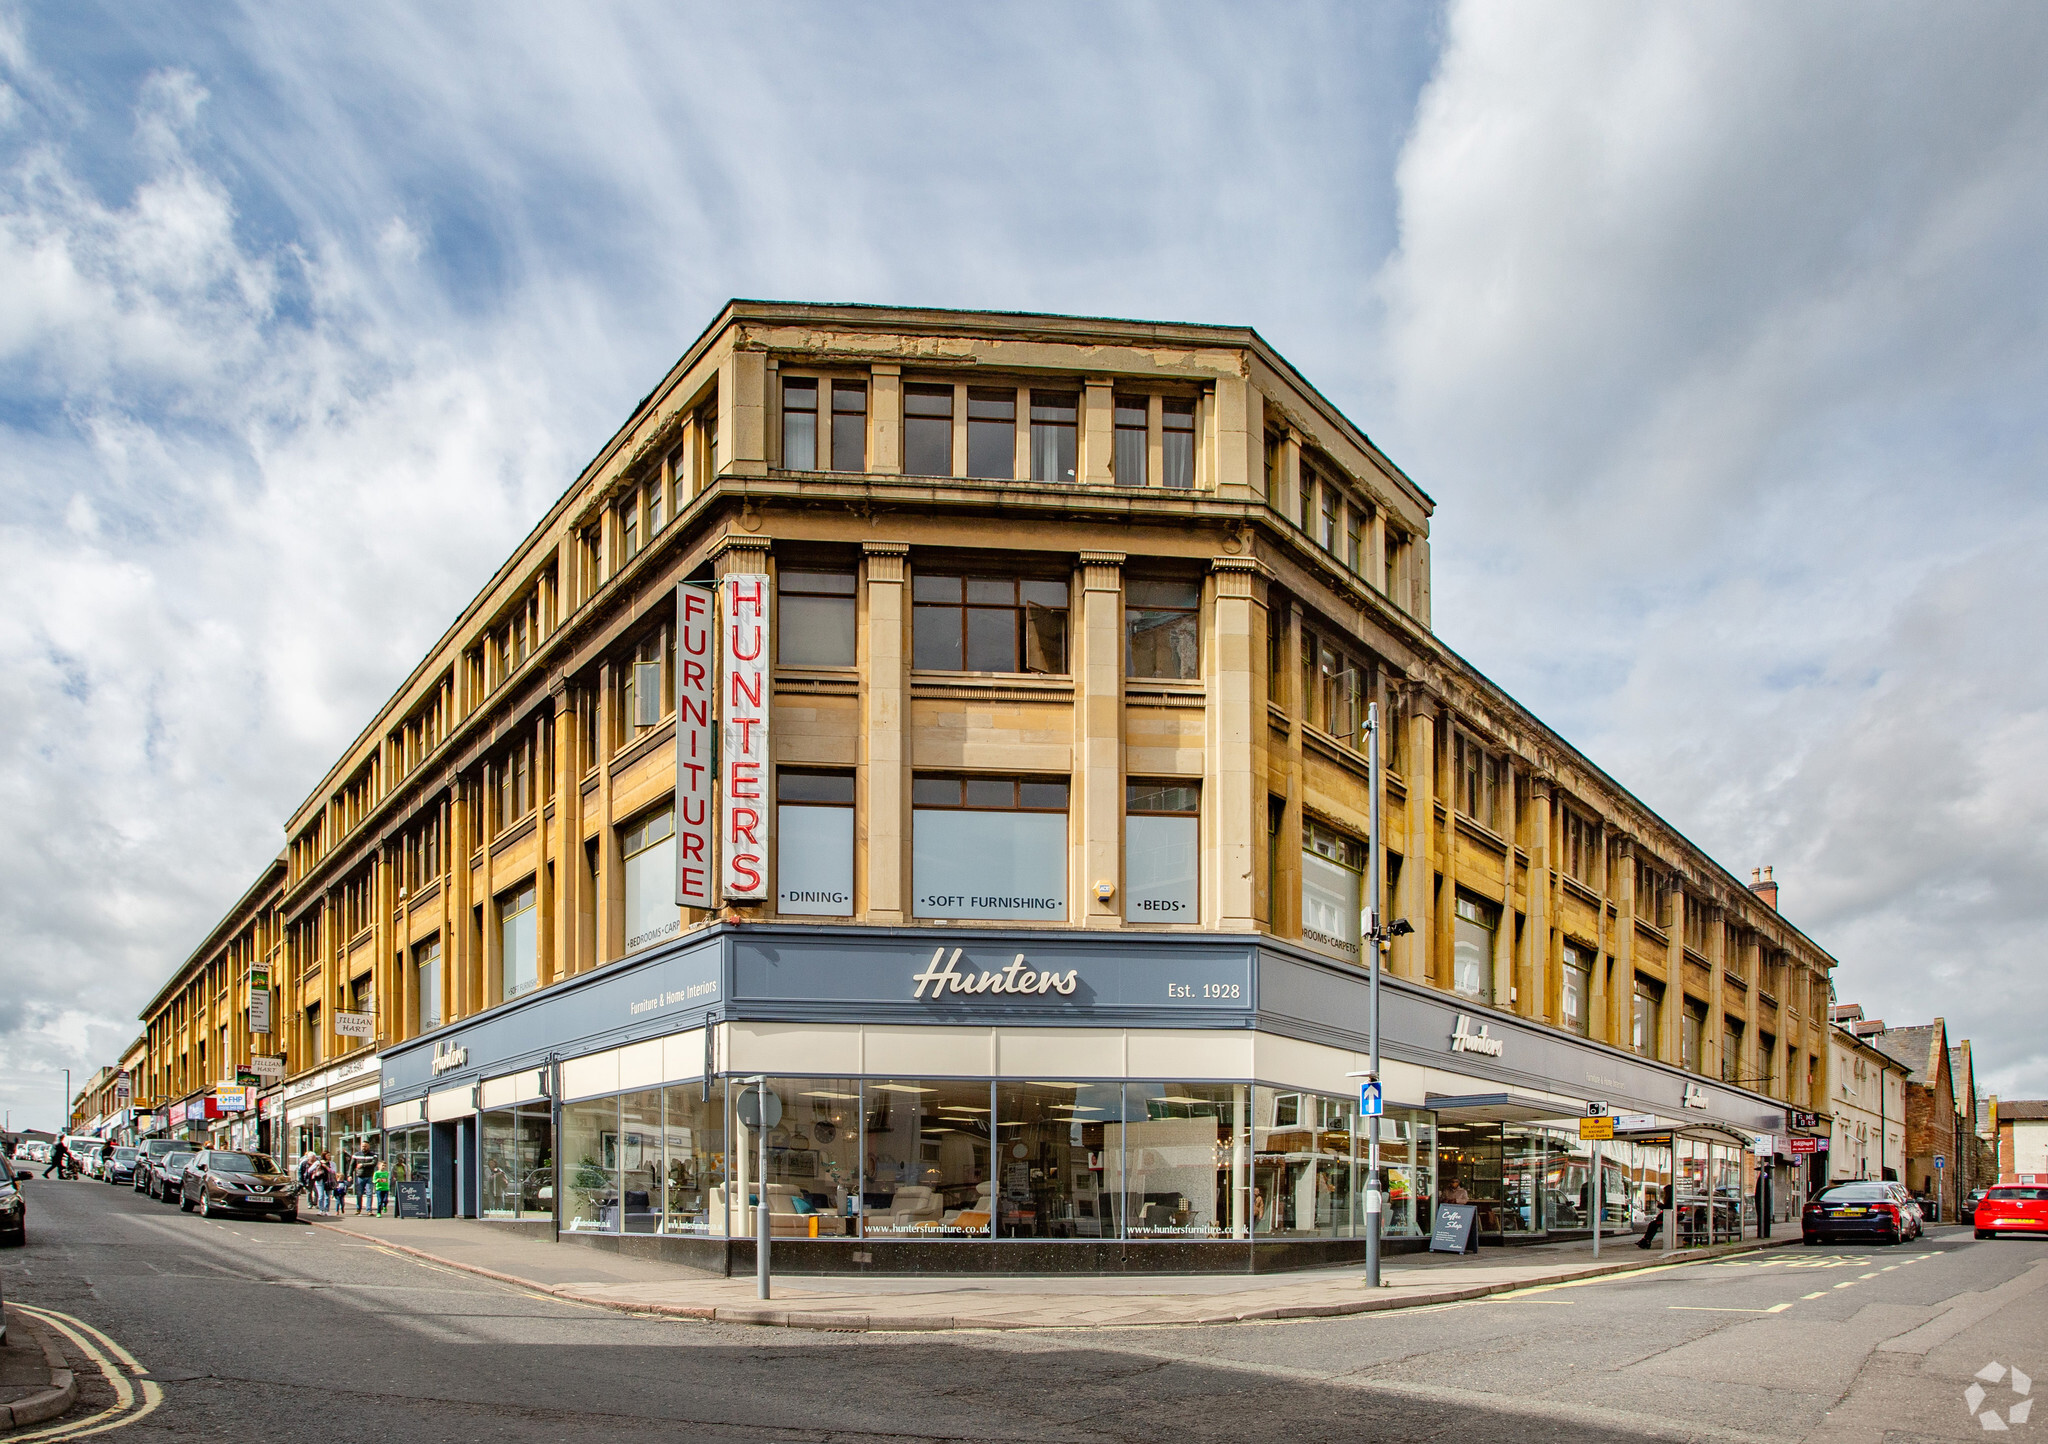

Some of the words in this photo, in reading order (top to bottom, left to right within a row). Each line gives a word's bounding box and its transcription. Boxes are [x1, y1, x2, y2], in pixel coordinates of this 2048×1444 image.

[731, 580, 761, 892] HUNTERS
[681, 594, 707, 897] FURNITURE
[790, 890, 843, 903] DINING
[928, 894, 965, 908] SOFT
[971, 896, 1056, 910] FURNISHING
[1144, 899, 1180, 912] BEDS
[630, 927, 662, 948] BEDROOMS
[1330, 937, 1356, 954] CARPETS
[913, 947, 1078, 999] Hunters
[630, 998, 658, 1015] Furniture
[659, 993, 665, 1007] &
[666, 990, 685, 1005] Home
[686, 980, 717, 999] Interiors
[1168, 983, 1196, 998] Est.
[1203, 984, 1241, 999] 1928
[337, 1016, 373, 1026] JILLIAN
[343, 1025, 367, 1033] HART
[1451, 1014, 1503, 1058] Hunters
[432, 1040, 467, 1076] Hunters
[1442, 1211, 1461, 1221] Coffee
[864, 1223, 991, 1235] www.huntersfurniture.co.uk
[1127, 1224, 1250, 1236] www.huntersfurniture.cok
[1445, 1221, 1463, 1230] Shop
